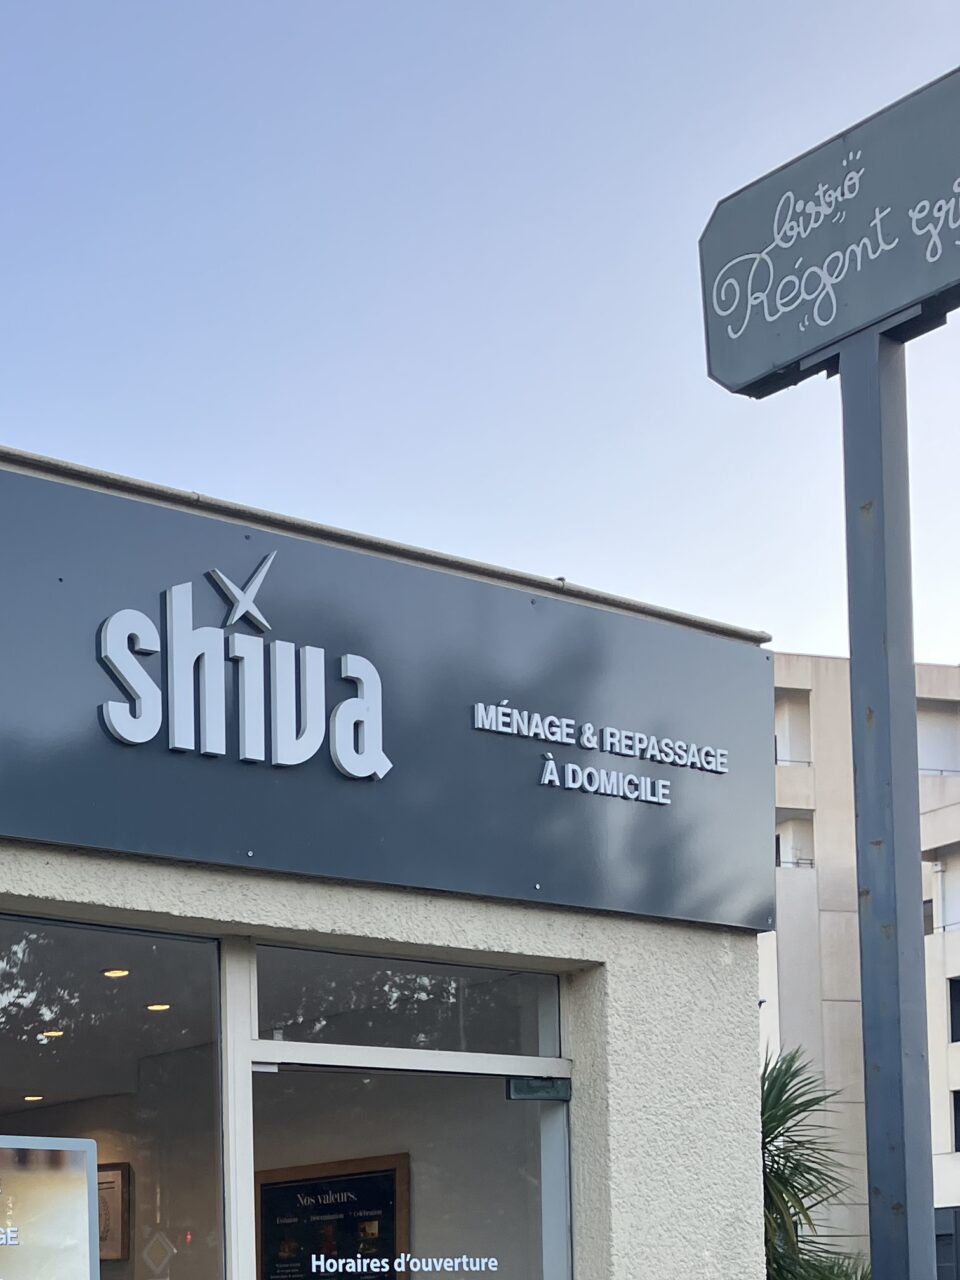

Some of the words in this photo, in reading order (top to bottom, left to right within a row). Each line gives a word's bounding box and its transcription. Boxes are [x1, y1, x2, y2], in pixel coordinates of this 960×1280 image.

[713, 206, 898, 339] Régent
[96, 581, 393, 780] shiva
[474, 700, 575, 746] MÉNAGE
[582, 723, 599, 749] &
[603, 727, 729, 775] REPASSAGE
[541, 752, 560, 786] À
[565, 763, 671, 805] DOMICILE
[296, 1193, 316, 1207] Nos
[311, 1254, 390, 1273] Horaires
